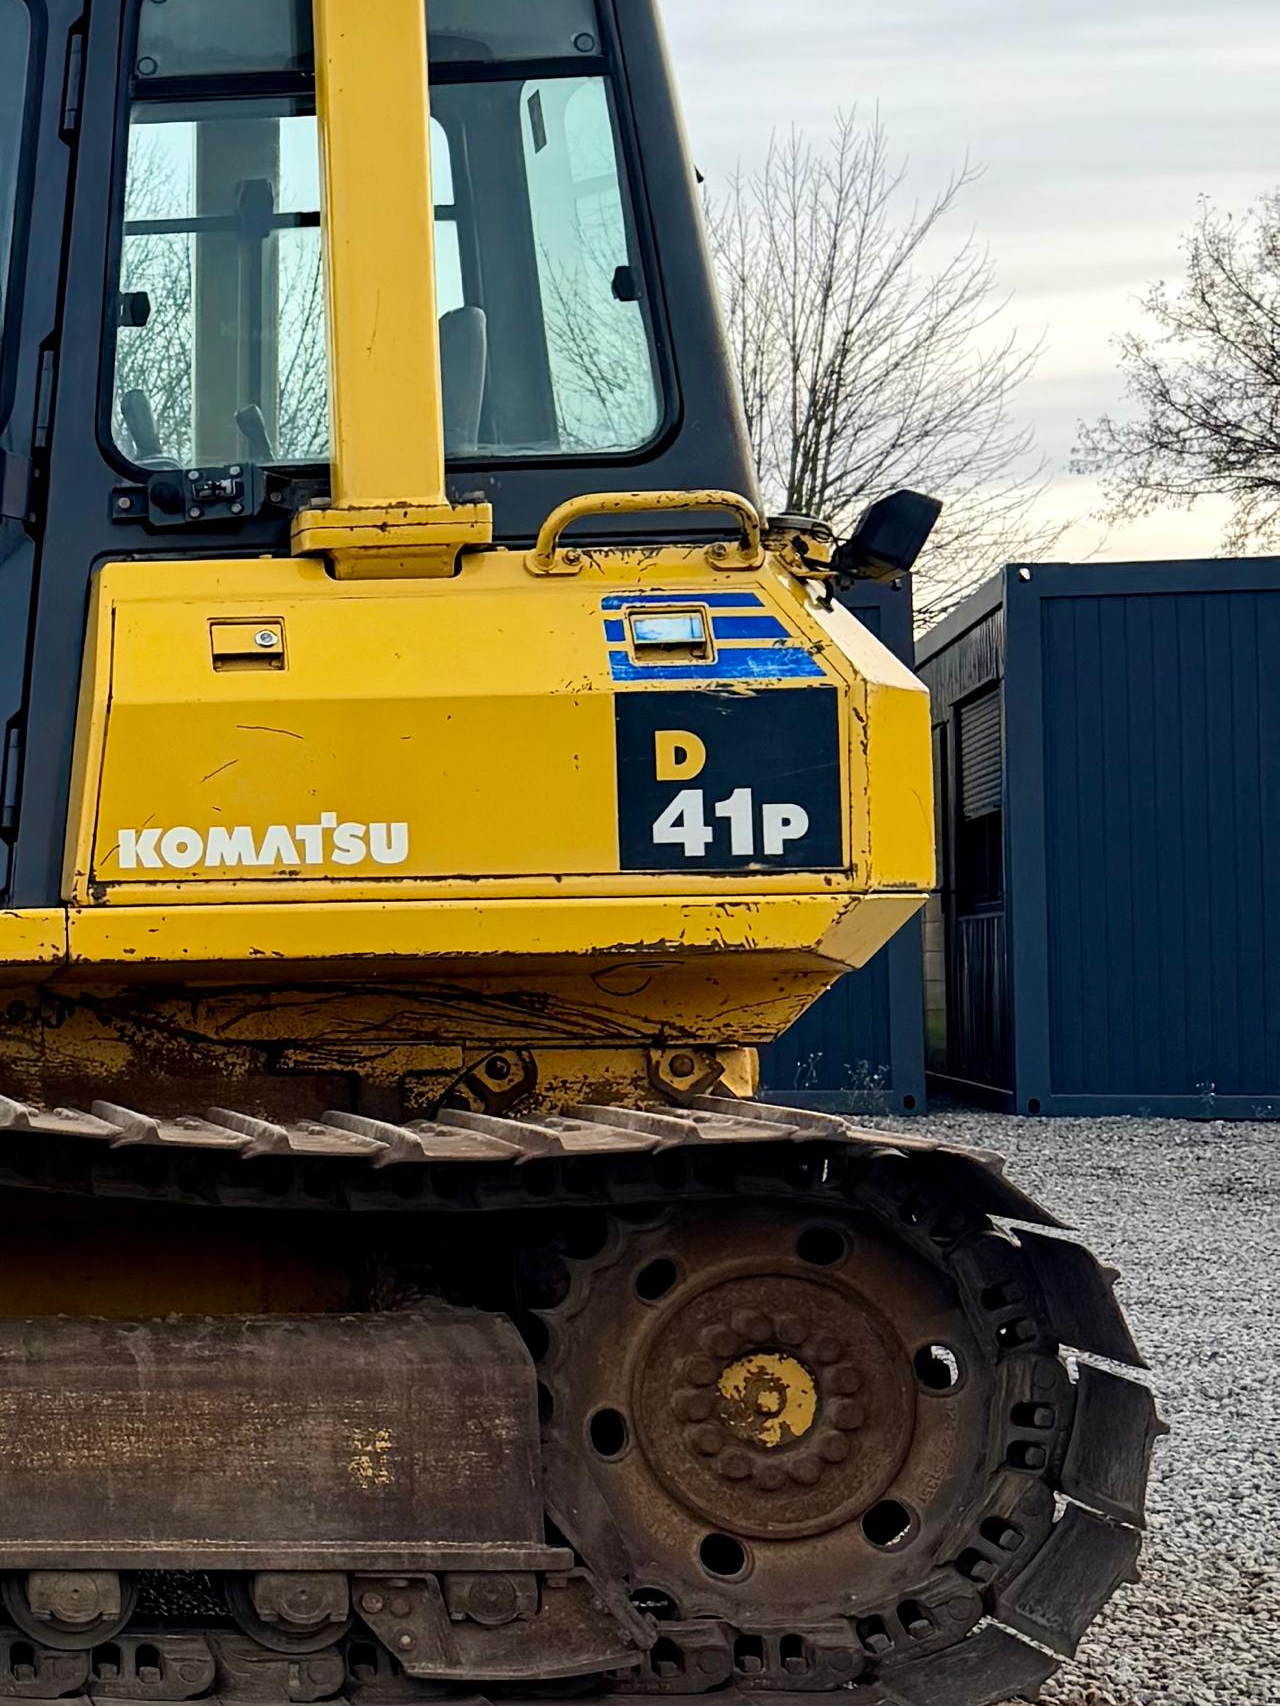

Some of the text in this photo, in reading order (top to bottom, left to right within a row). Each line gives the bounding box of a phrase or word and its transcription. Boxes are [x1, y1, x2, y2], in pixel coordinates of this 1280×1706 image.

[654, 729, 707, 782] D
[117, 811, 409, 869] KOMATSU
[652, 787, 810, 857] 41P
